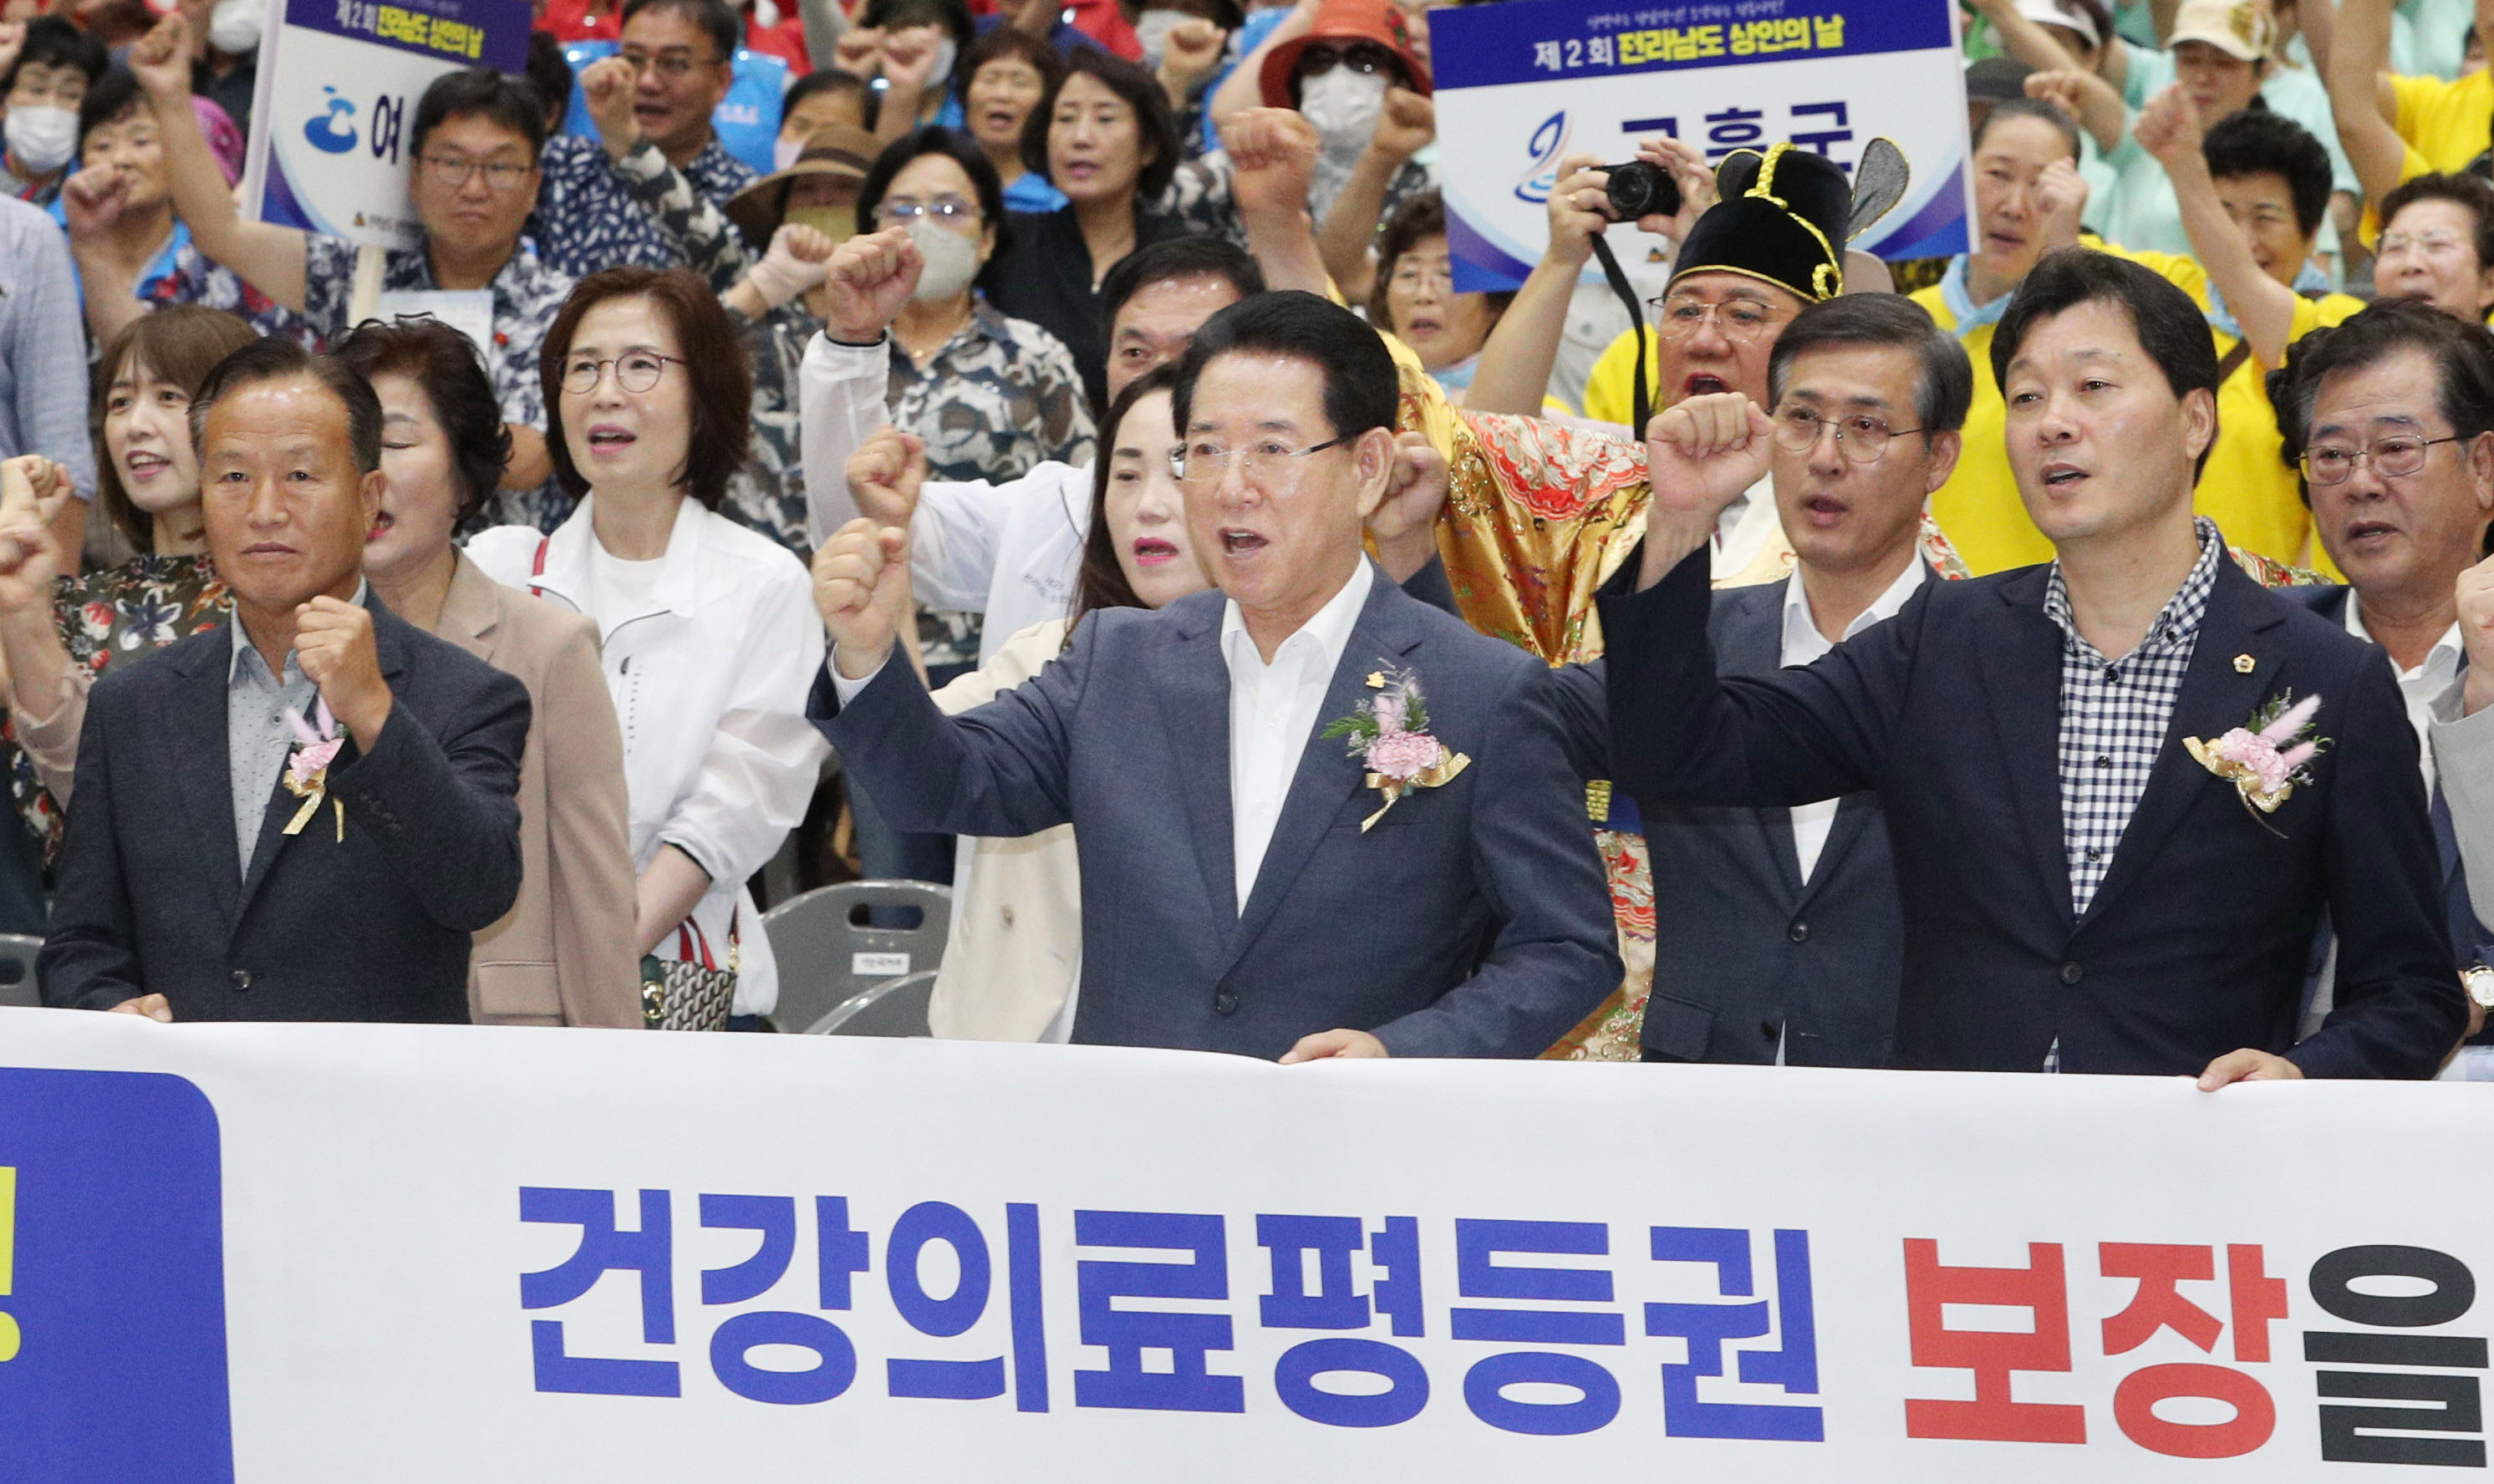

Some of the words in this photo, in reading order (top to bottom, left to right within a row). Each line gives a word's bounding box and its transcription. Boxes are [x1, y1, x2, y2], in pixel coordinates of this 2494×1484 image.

[1533, 36, 1615, 72] 제2회
[1616, 24, 1726, 65] 전라남도
[1729, 17, 1811, 56] 상인의
[1814, 13, 1845, 49] 날
[520, 1186, 1825, 1443] 건강의료평등권
[1903, 1238, 2490, 1469] 보장을
